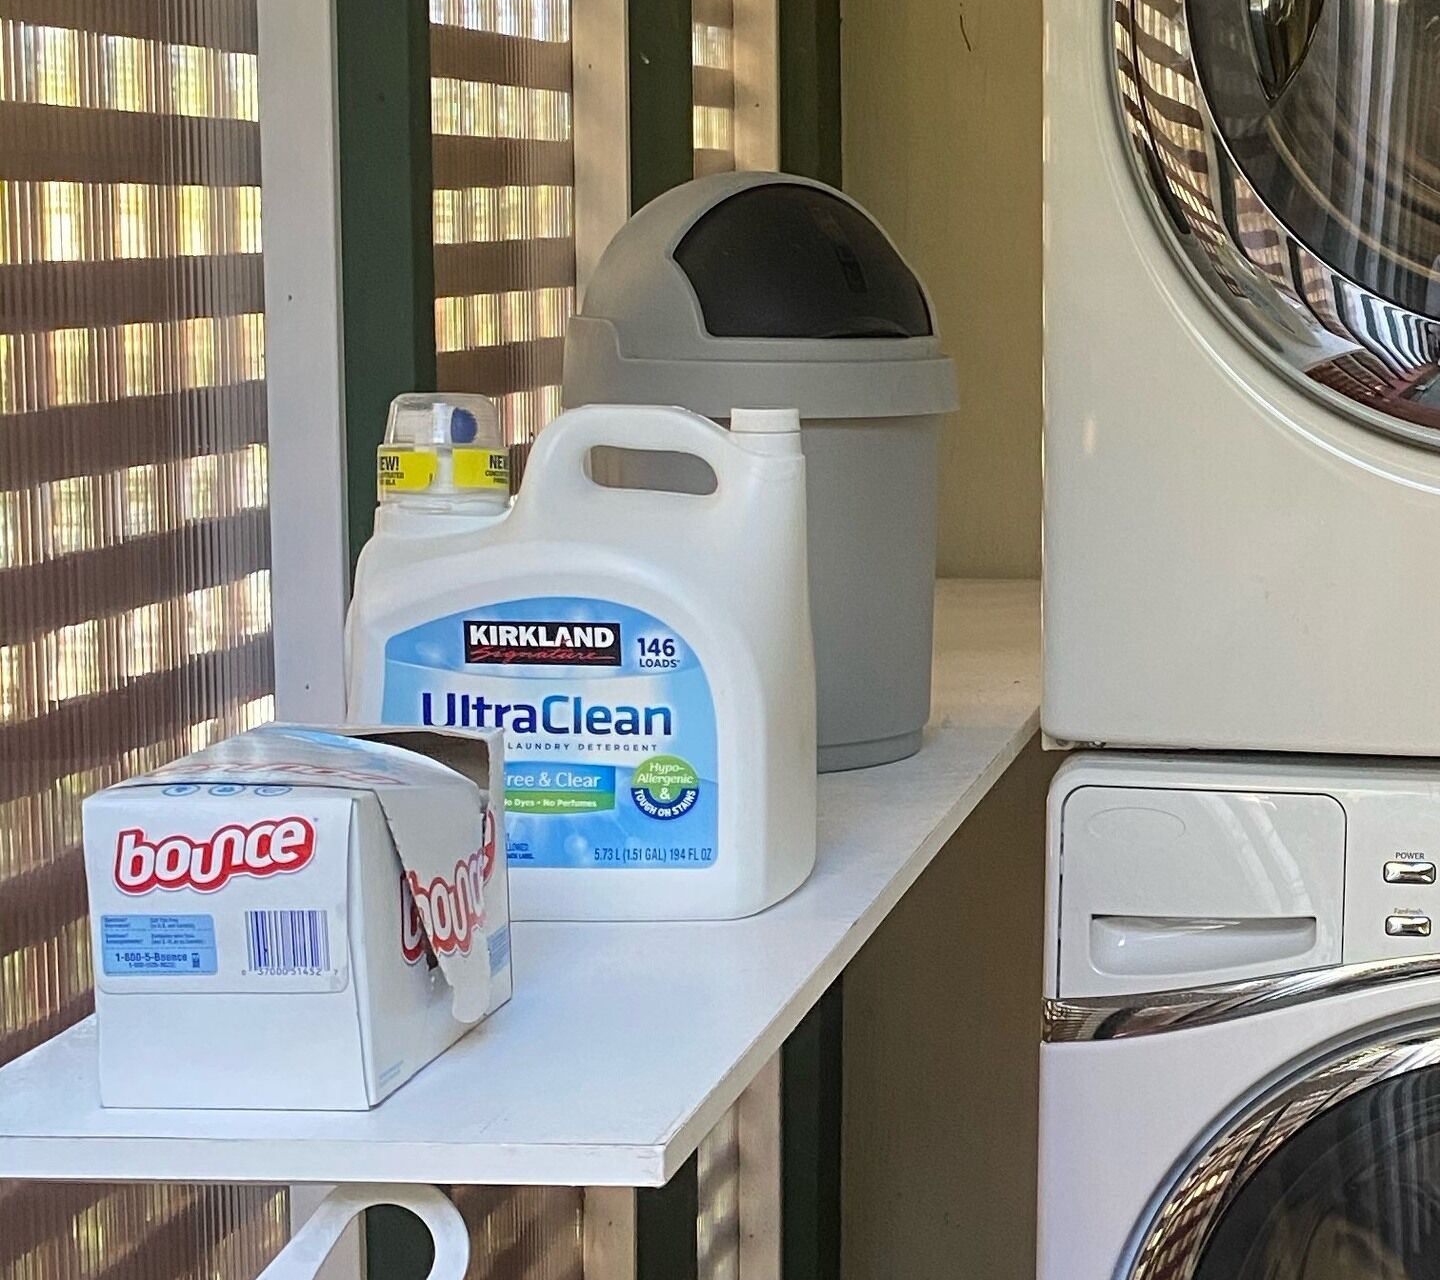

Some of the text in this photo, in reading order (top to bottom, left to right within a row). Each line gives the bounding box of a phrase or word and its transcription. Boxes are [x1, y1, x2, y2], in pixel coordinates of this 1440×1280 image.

[380, 456, 399, 471] EW!
[469, 625, 615, 649] KIRKLAND
[637, 638, 675, 657] 146
[422, 692, 672, 736] UltraClean
[508, 742, 658, 751] LAUNDRY DETERGENT
[649, 762, 685, 775] Hypo-
[504, 771, 602, 788] ree & Clear
[637, 773, 694, 786] Allergenic
[659, 787, 671, 800] &
[514, 799, 535, 808] Dyes
[543, 799, 556, 807] No
[557, 800, 597, 808] Perfumes
[634, 789, 697, 817] TOUGH ON STAINS
[117, 816, 313, 890] bounce
[594, 848, 712, 863] 5.73 L (1.51 GAL) 194 FL OZ
[1395, 851, 1425, 860] POWER
